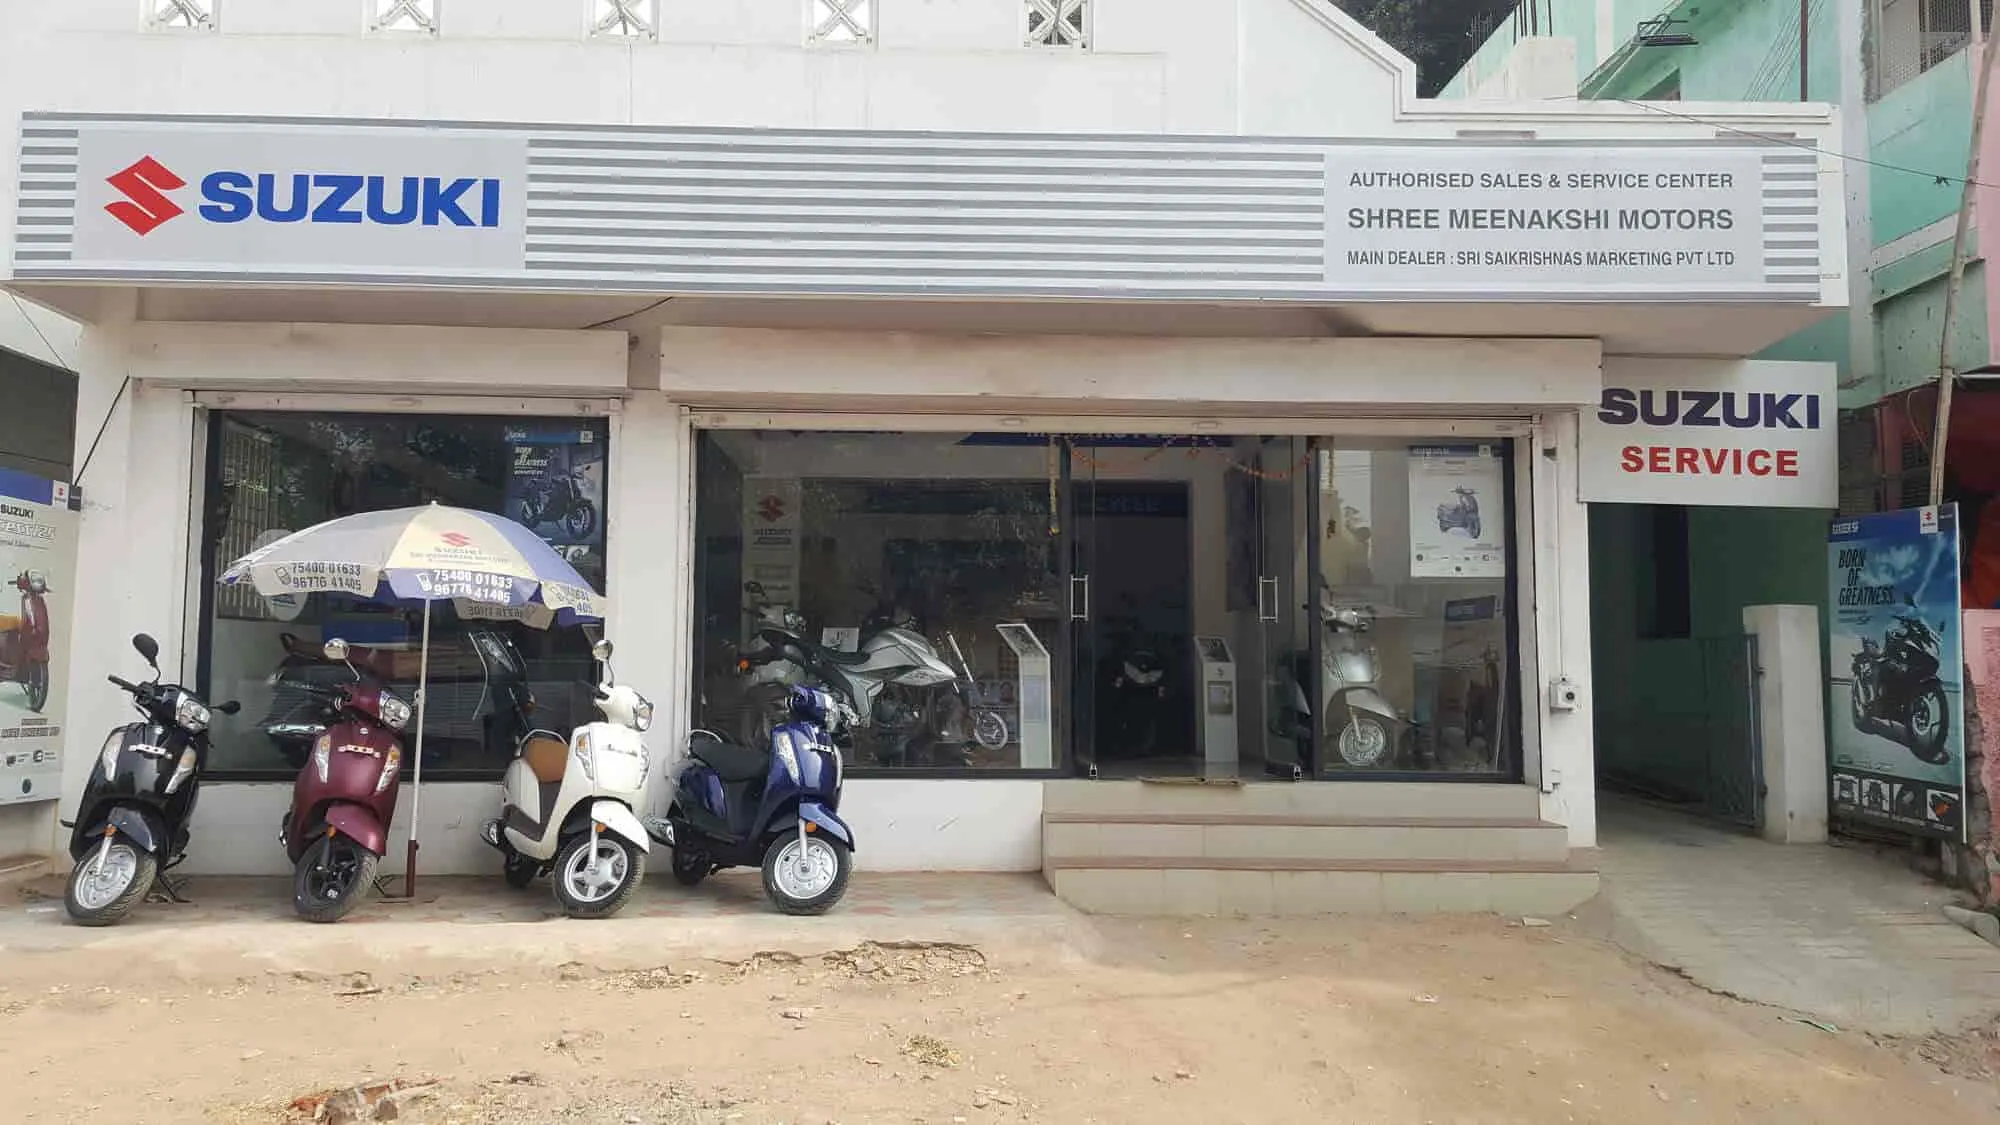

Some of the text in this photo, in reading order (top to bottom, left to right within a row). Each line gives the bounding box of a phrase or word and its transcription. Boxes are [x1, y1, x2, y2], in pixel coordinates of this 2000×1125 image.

[1349, 172, 1733, 189] AUTHORISED SALES & SERVICE CENTER
[199, 171, 500, 228] SUZUKI
[1348, 207, 1734, 230] SHREE MEENAKSHI MOTORS
[1347, 250, 1384, 265] MAIN
[1388, 250, 1446, 265] DEALER
[1456, 250, 1481, 266] SRI
[1484, 250, 1583, 266] SAIKRISHNAS
[1586, 250, 1673, 266] MARKETING
[1676, 251, 1704, 265] PVT
[1707, 251, 1735, 266] LTD
[1598, 388, 1820, 429] SUZUKI
[1620, 446, 1799, 477] SERVICE
[0, 504, 34, 519] SUZUKI
[1839, 548, 1868, 568] BORN
[291, 562, 361, 577] 75400 01633
[433, 569, 472, 582] 75400
[1847, 568, 1861, 586] OF
